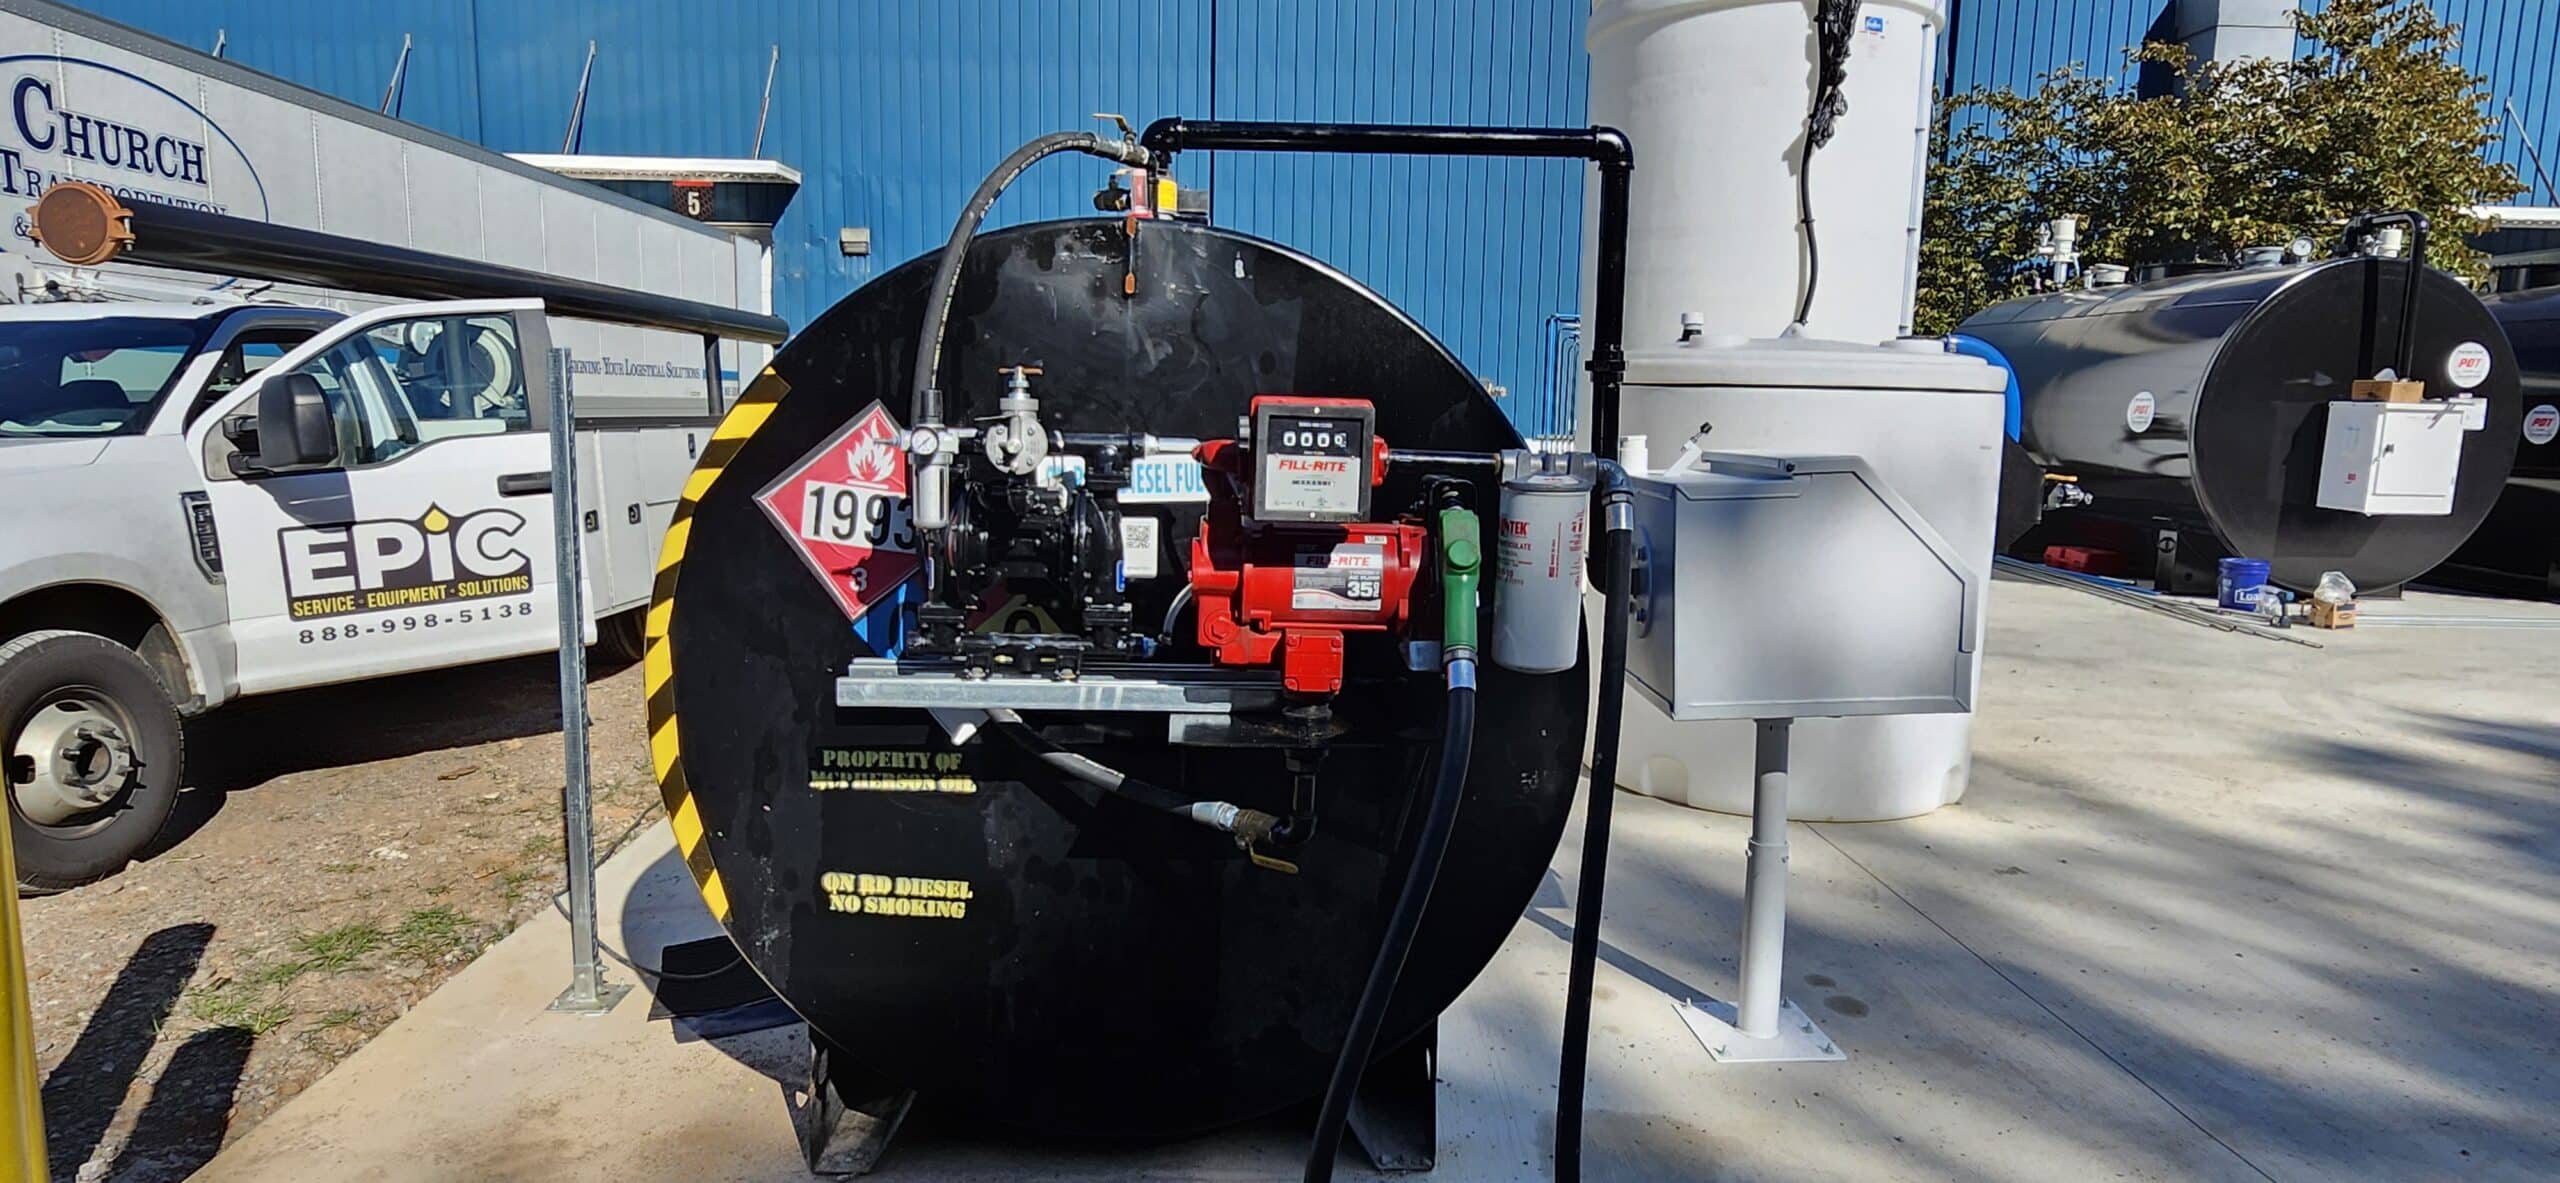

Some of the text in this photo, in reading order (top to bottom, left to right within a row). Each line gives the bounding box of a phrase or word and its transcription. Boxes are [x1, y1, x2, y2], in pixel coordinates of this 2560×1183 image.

[13, 77, 207, 184] CHURCH
[688, 191, 700, 215] 5
[1135, 463, 1172, 494] ESEL
[1279, 459, 1347, 472] FILL-RITE
[809, 486, 915, 549] 1993
[849, 567, 868, 592] 3
[293, 575, 529, 617] SERVICE EQUIPMENT SOLUTIONS
[298, 601, 534, 644] 888-998-5138
[823, 750, 963, 772] PROPERTY OF
[821, 871, 856, 893] ON
[894, 877, 973, 899] DIESEL
[829, 894, 966, 919] NO SMOKING
